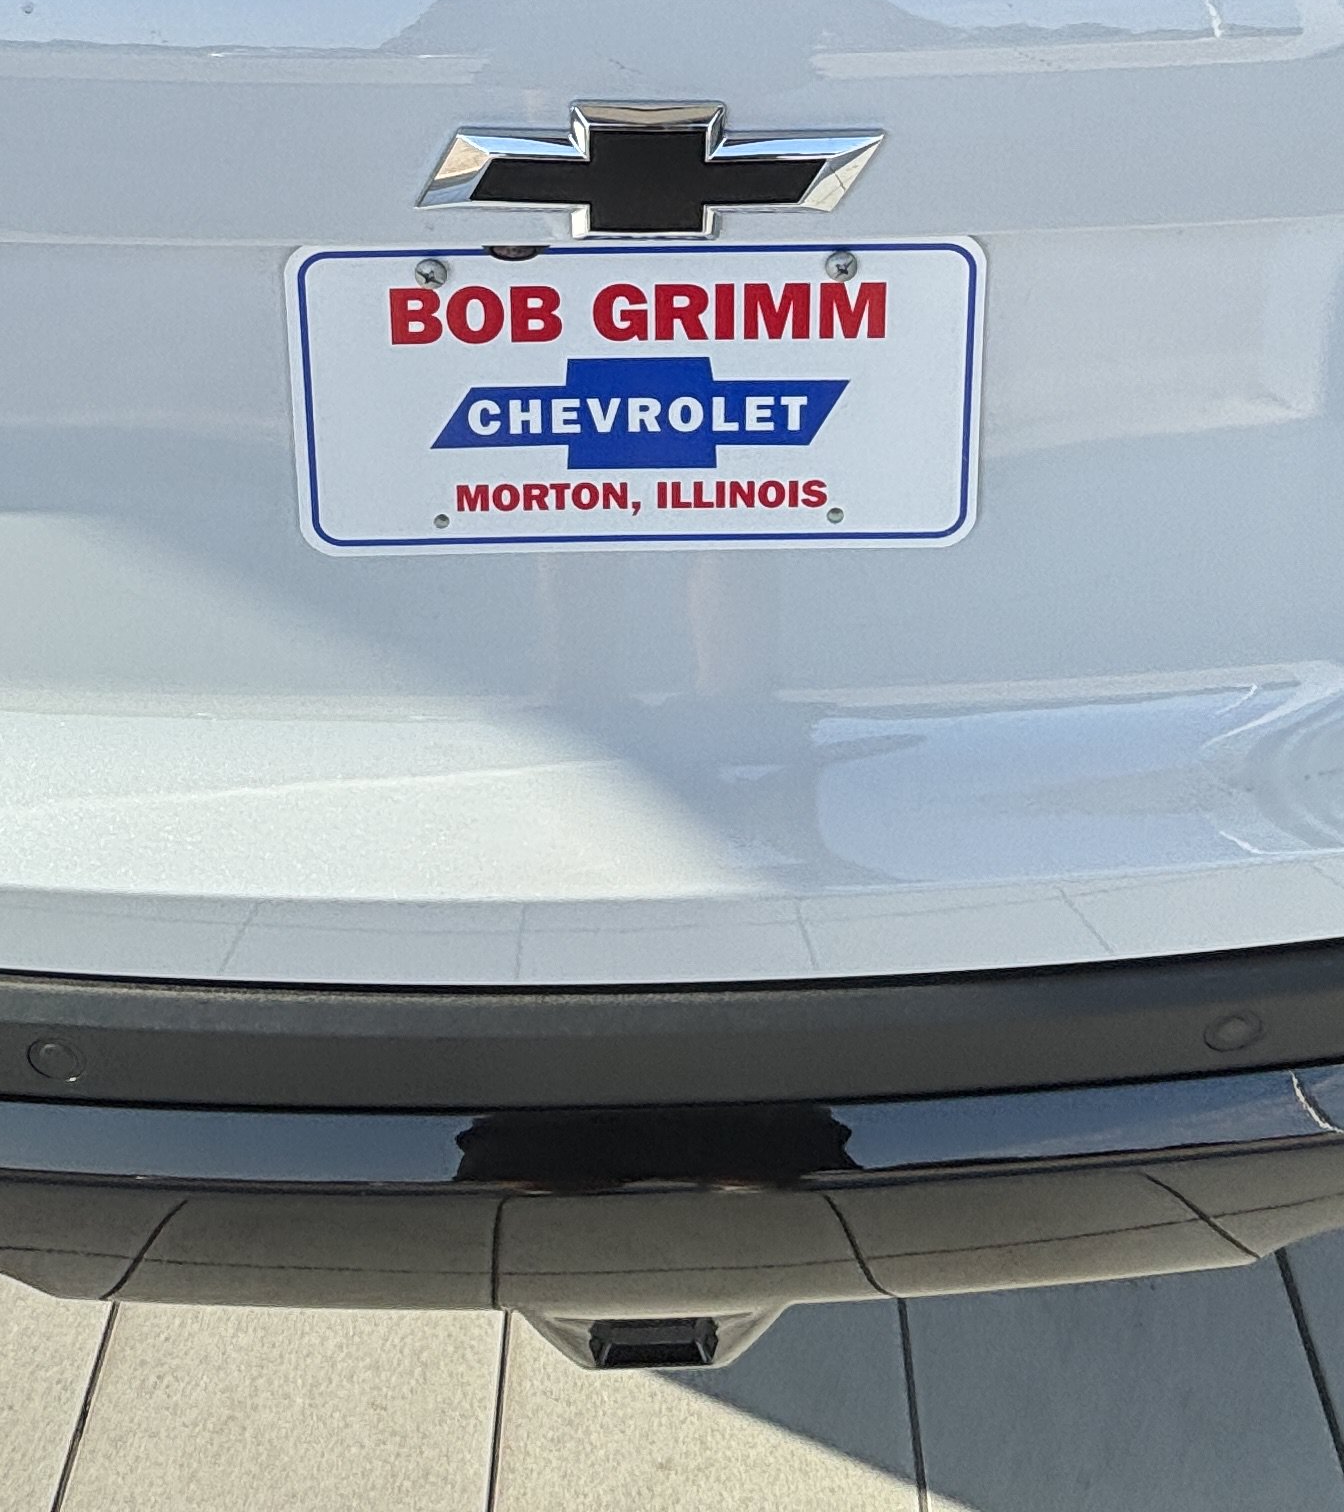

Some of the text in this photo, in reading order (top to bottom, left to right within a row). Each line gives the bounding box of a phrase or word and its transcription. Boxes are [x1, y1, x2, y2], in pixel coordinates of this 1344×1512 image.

[389, 282, 887, 345] BOB GRIMM
[467, 396, 808, 436] CHEVROLET
[456, 479, 828, 516] MORTON, ILLINOIS
